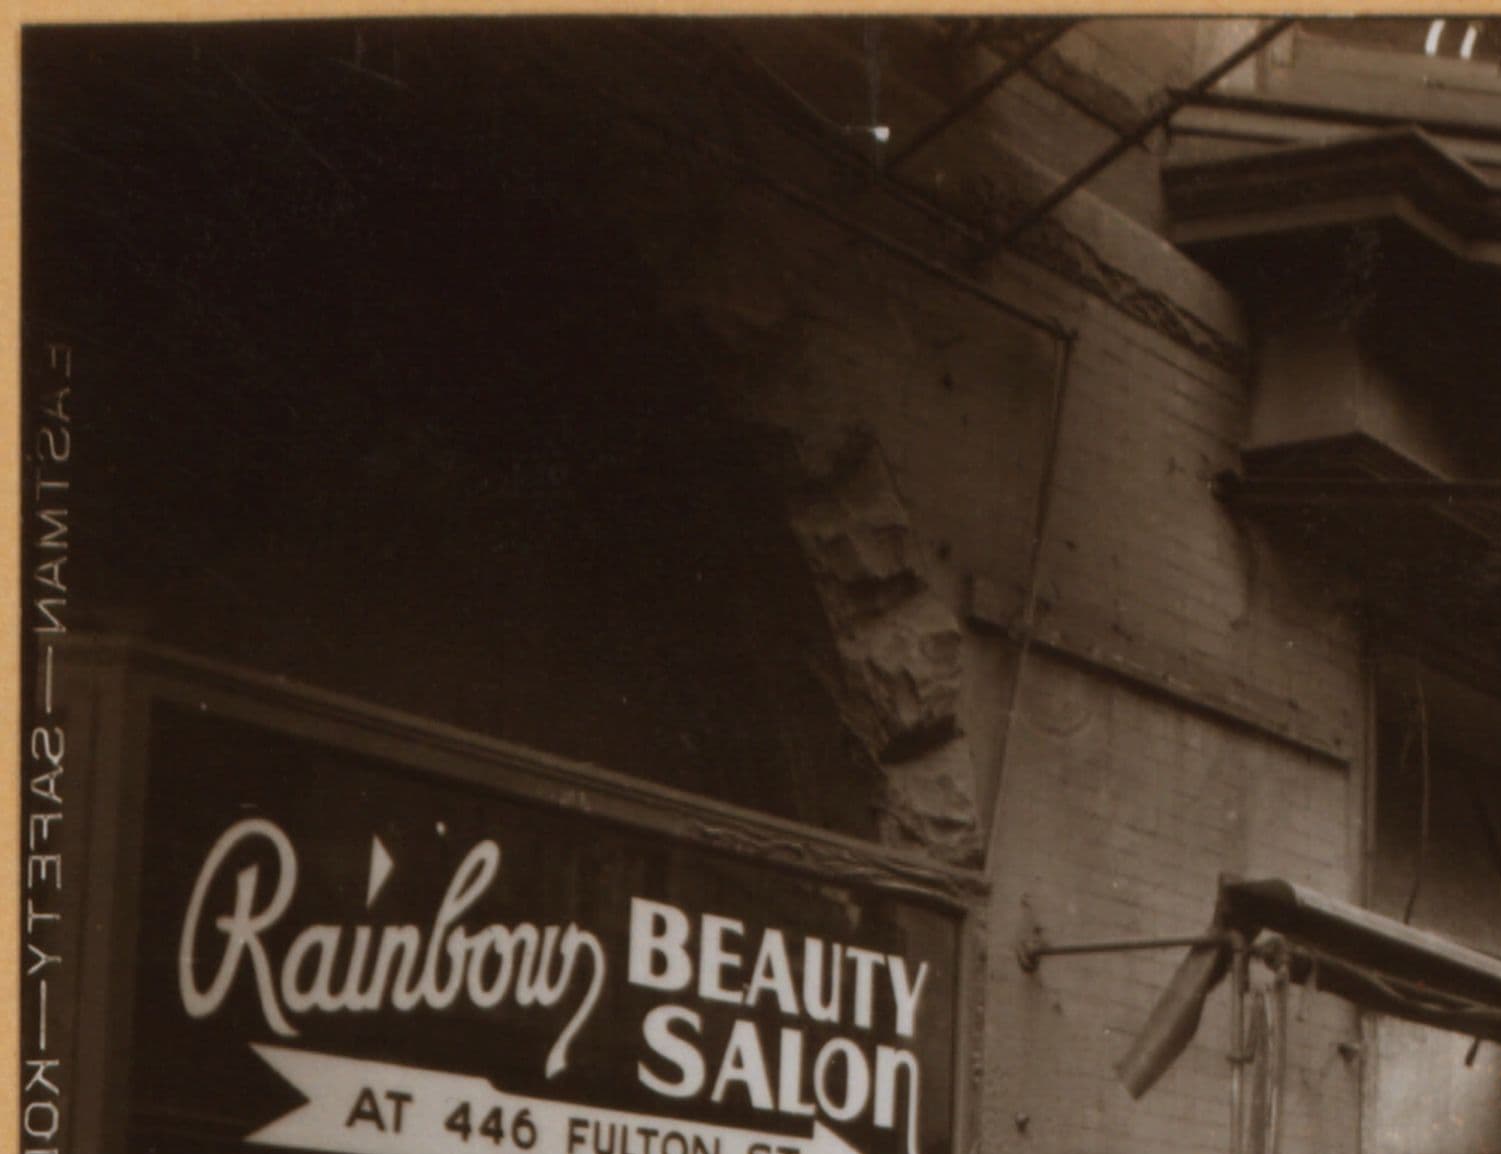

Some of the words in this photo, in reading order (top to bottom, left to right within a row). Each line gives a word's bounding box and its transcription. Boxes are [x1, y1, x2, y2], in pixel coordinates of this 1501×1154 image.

[178, 817, 607, 1079] Rainbow
[628, 896, 929, 1038] BEAUTY
[345, 1086, 413, 1135] AT
[443, 1101, 539, 1151] 446
